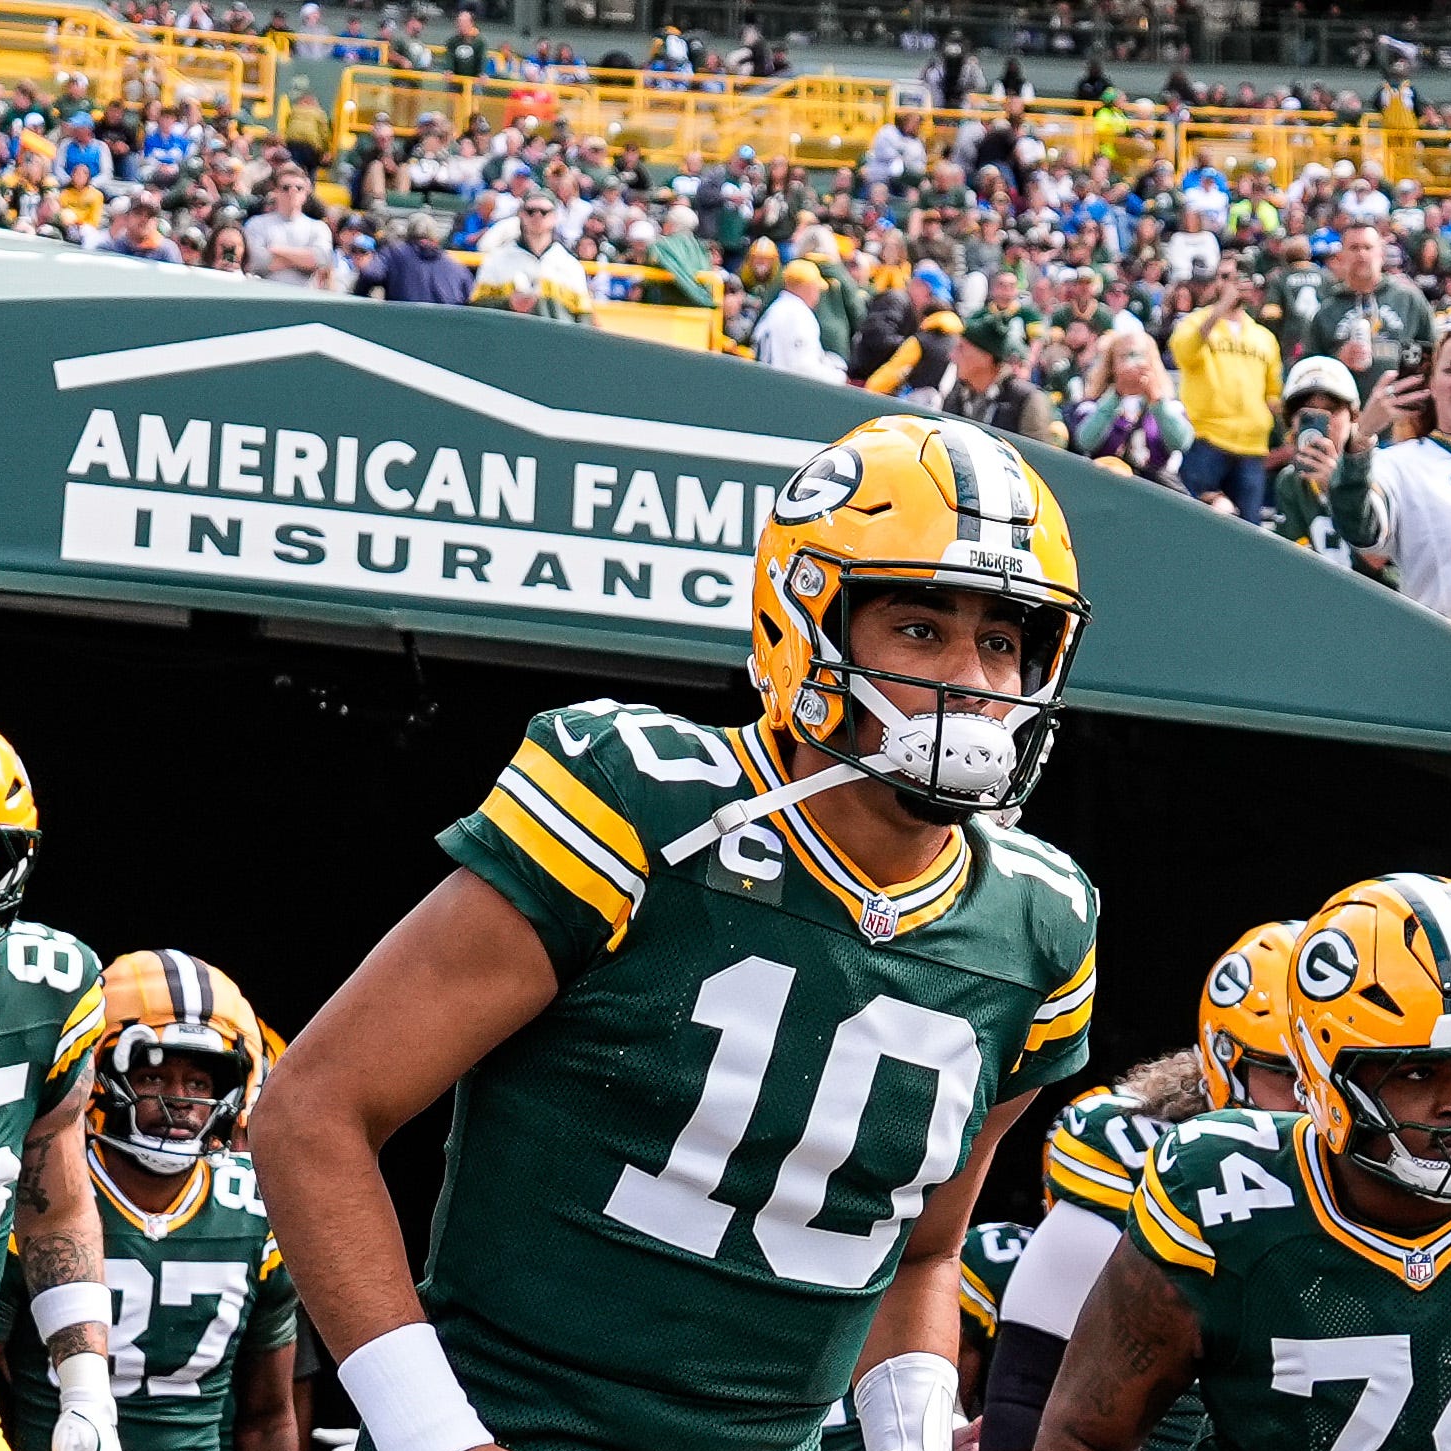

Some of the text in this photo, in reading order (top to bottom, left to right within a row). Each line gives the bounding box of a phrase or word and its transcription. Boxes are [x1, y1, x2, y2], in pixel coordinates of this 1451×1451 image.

[67, 408, 775, 546] AMERICAN FAMI
[134, 508, 733, 609] INSURANC
[970, 550, 1023, 574] PACKERS
[718, 822, 784, 881] C
[866, 912, 890, 936] NFL
[602, 955, 983, 1290] 10
[1178, 1108, 1295, 1228] 74
[1410, 1264, 1431, 1280] NFL
